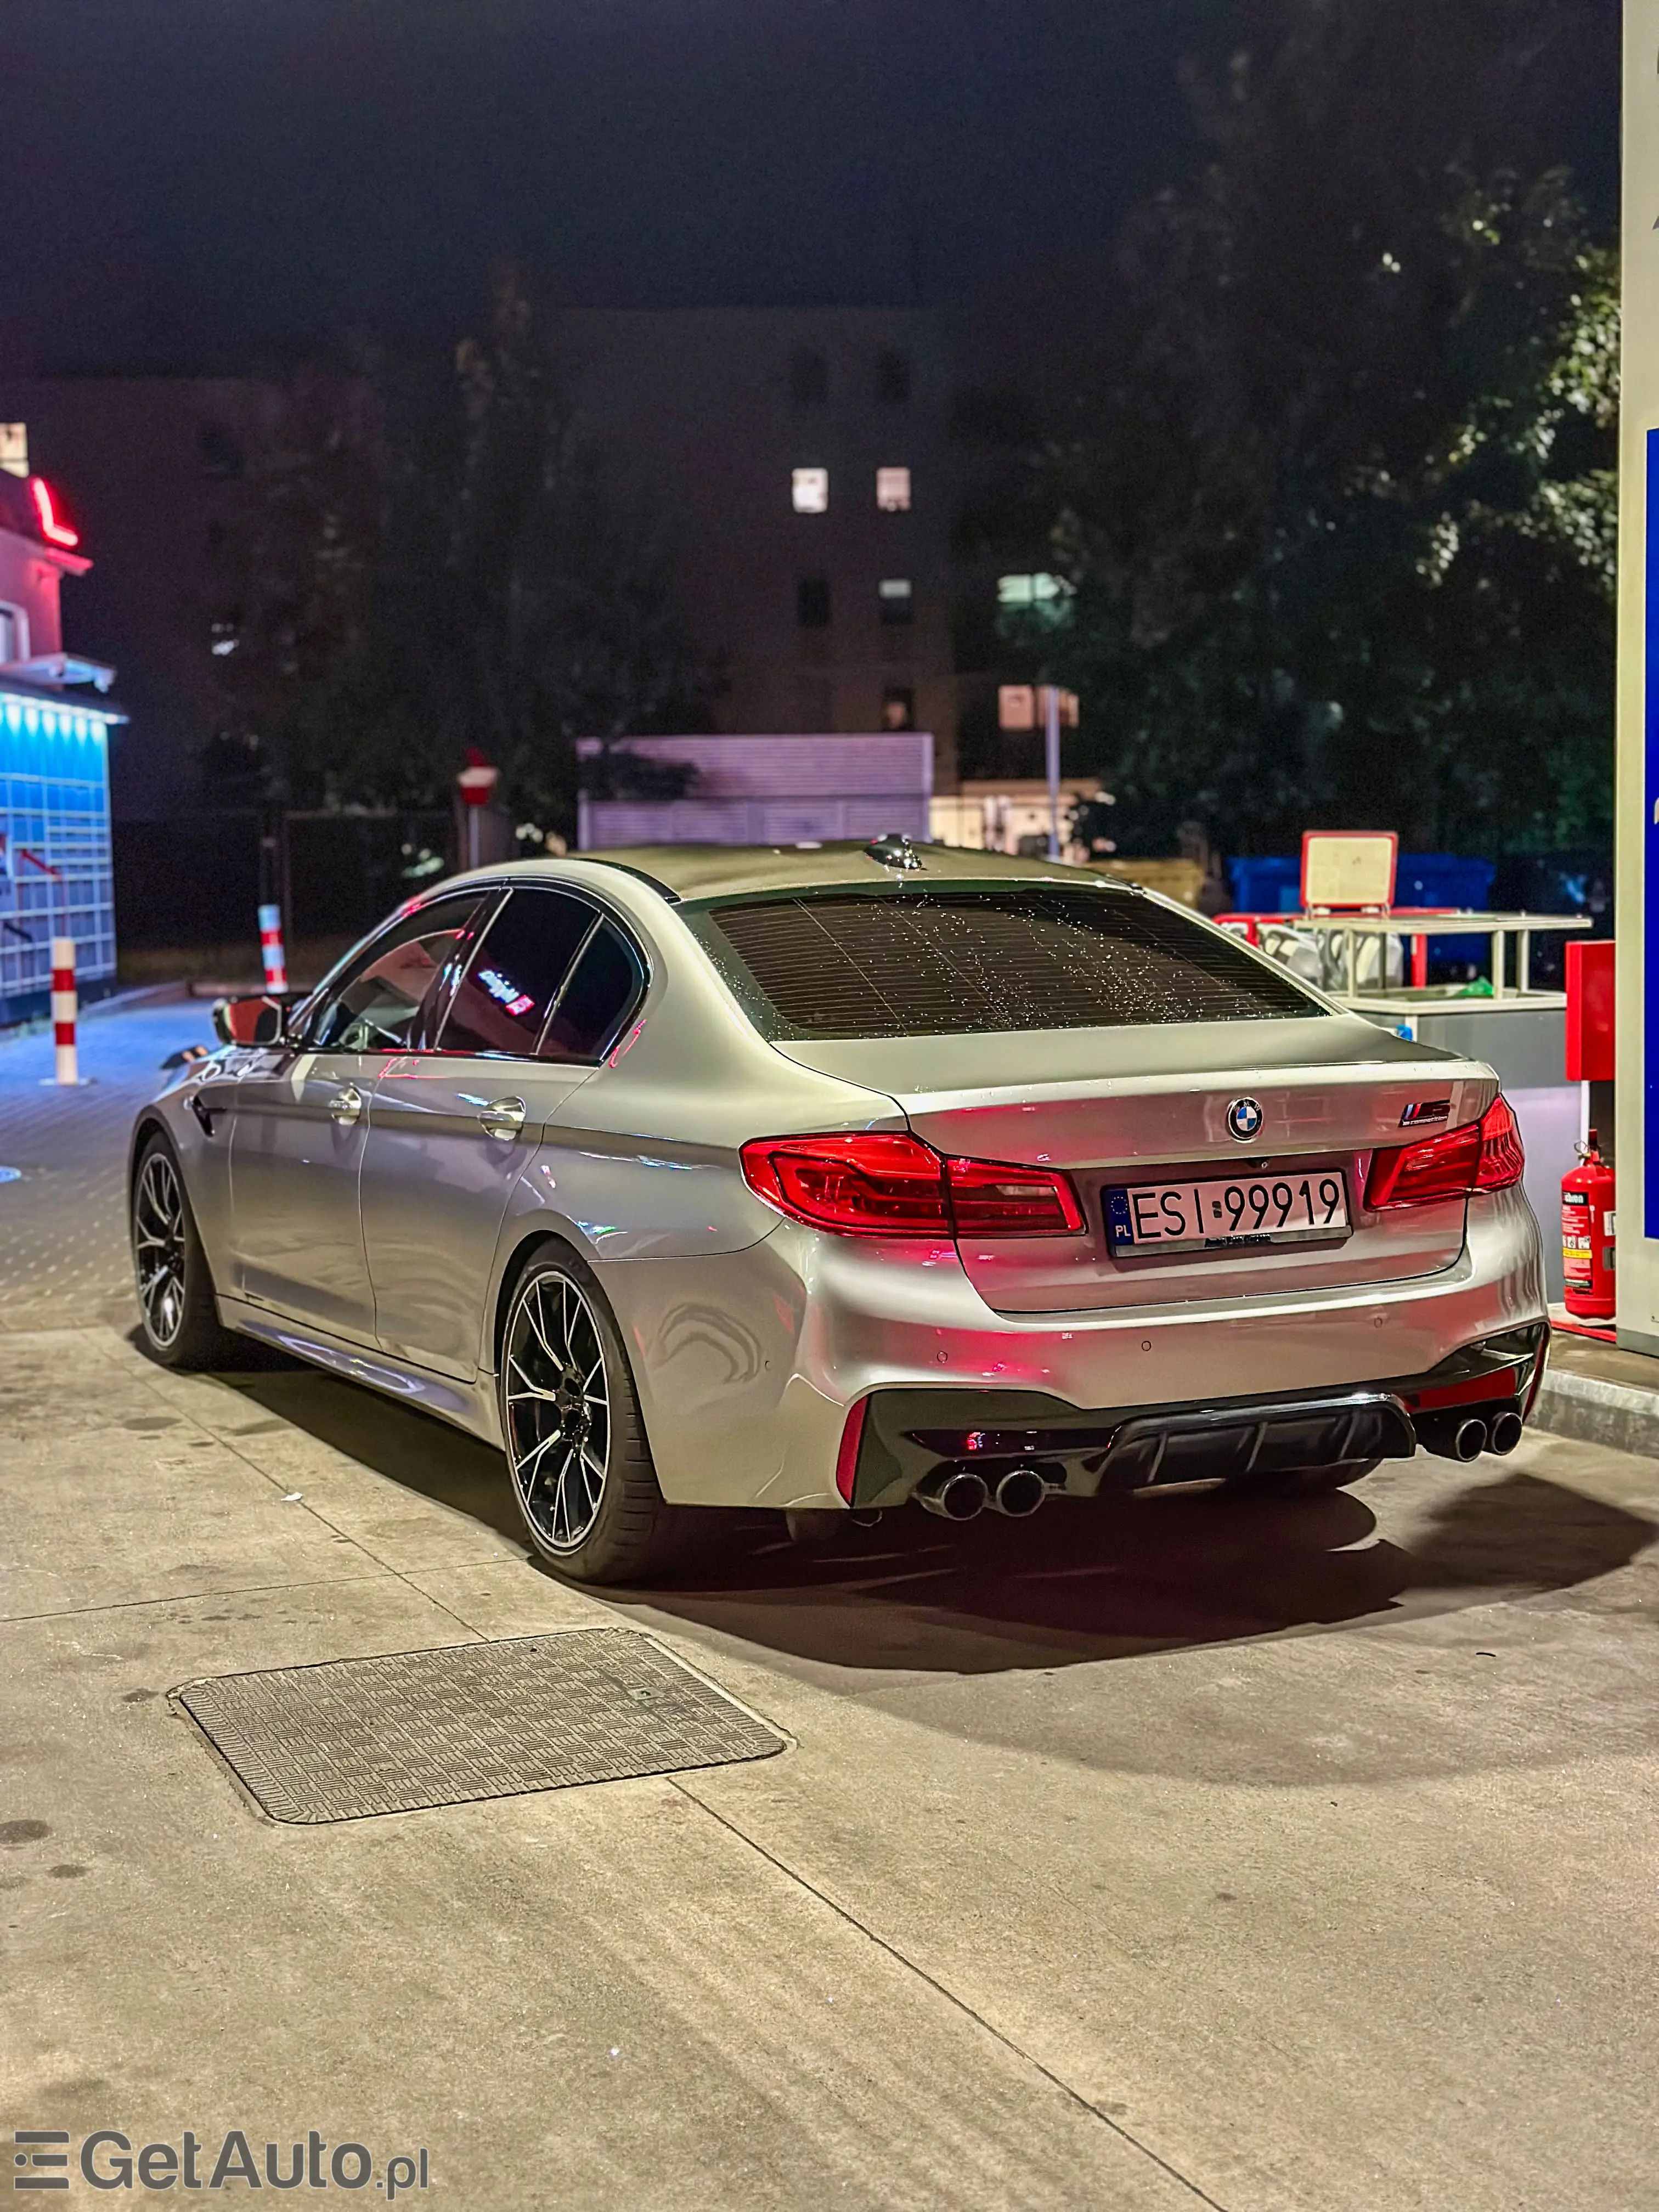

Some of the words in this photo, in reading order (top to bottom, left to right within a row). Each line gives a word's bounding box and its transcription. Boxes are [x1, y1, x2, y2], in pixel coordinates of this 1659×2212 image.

[1132, 1188, 1205, 1239] ESI
[1224, 1178, 1339, 1232] 99919
[1115, 1225, 1131, 1237] PL
